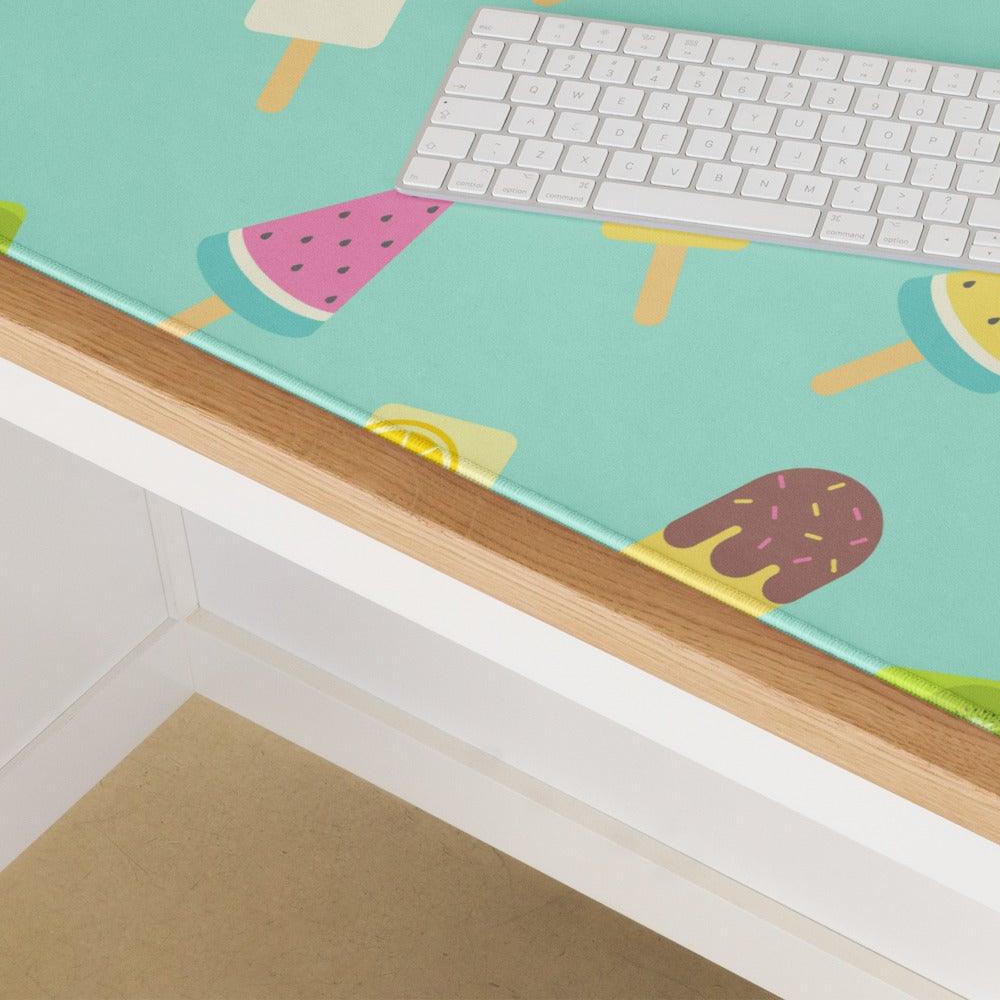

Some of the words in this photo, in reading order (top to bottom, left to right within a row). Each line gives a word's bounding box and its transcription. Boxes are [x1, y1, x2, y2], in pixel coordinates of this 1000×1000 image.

[529, 85, 539, 95] Q
[572, 91, 584, 99] W
[617, 97, 626, 105] E
[661, 102, 670, 111] R
[751, 114, 759, 122] Y
[795, 119, 804, 127] U
[884, 131, 893, 139] O
[929, 136, 938, 144] P
[536, 150, 545, 159] Z
[580, 156, 590, 164] X
[625, 161, 634, 170] C
[671, 167, 680, 176] V
[759, 180, 770, 188] N
[804, 184, 816, 193] M
[615, 129, 625, 137] D
[660, 134, 668, 142] F
[704, 140, 713, 148] G
[749, 145, 759, 154] H
[794, 151, 802, 160] J
[839, 156, 849, 165] K
[884, 163, 891, 171] L
[502, 187, 527, 195] option
[545, 192, 584, 203] command
[825, 228, 865, 241] command
[883, 236, 909, 246] option
